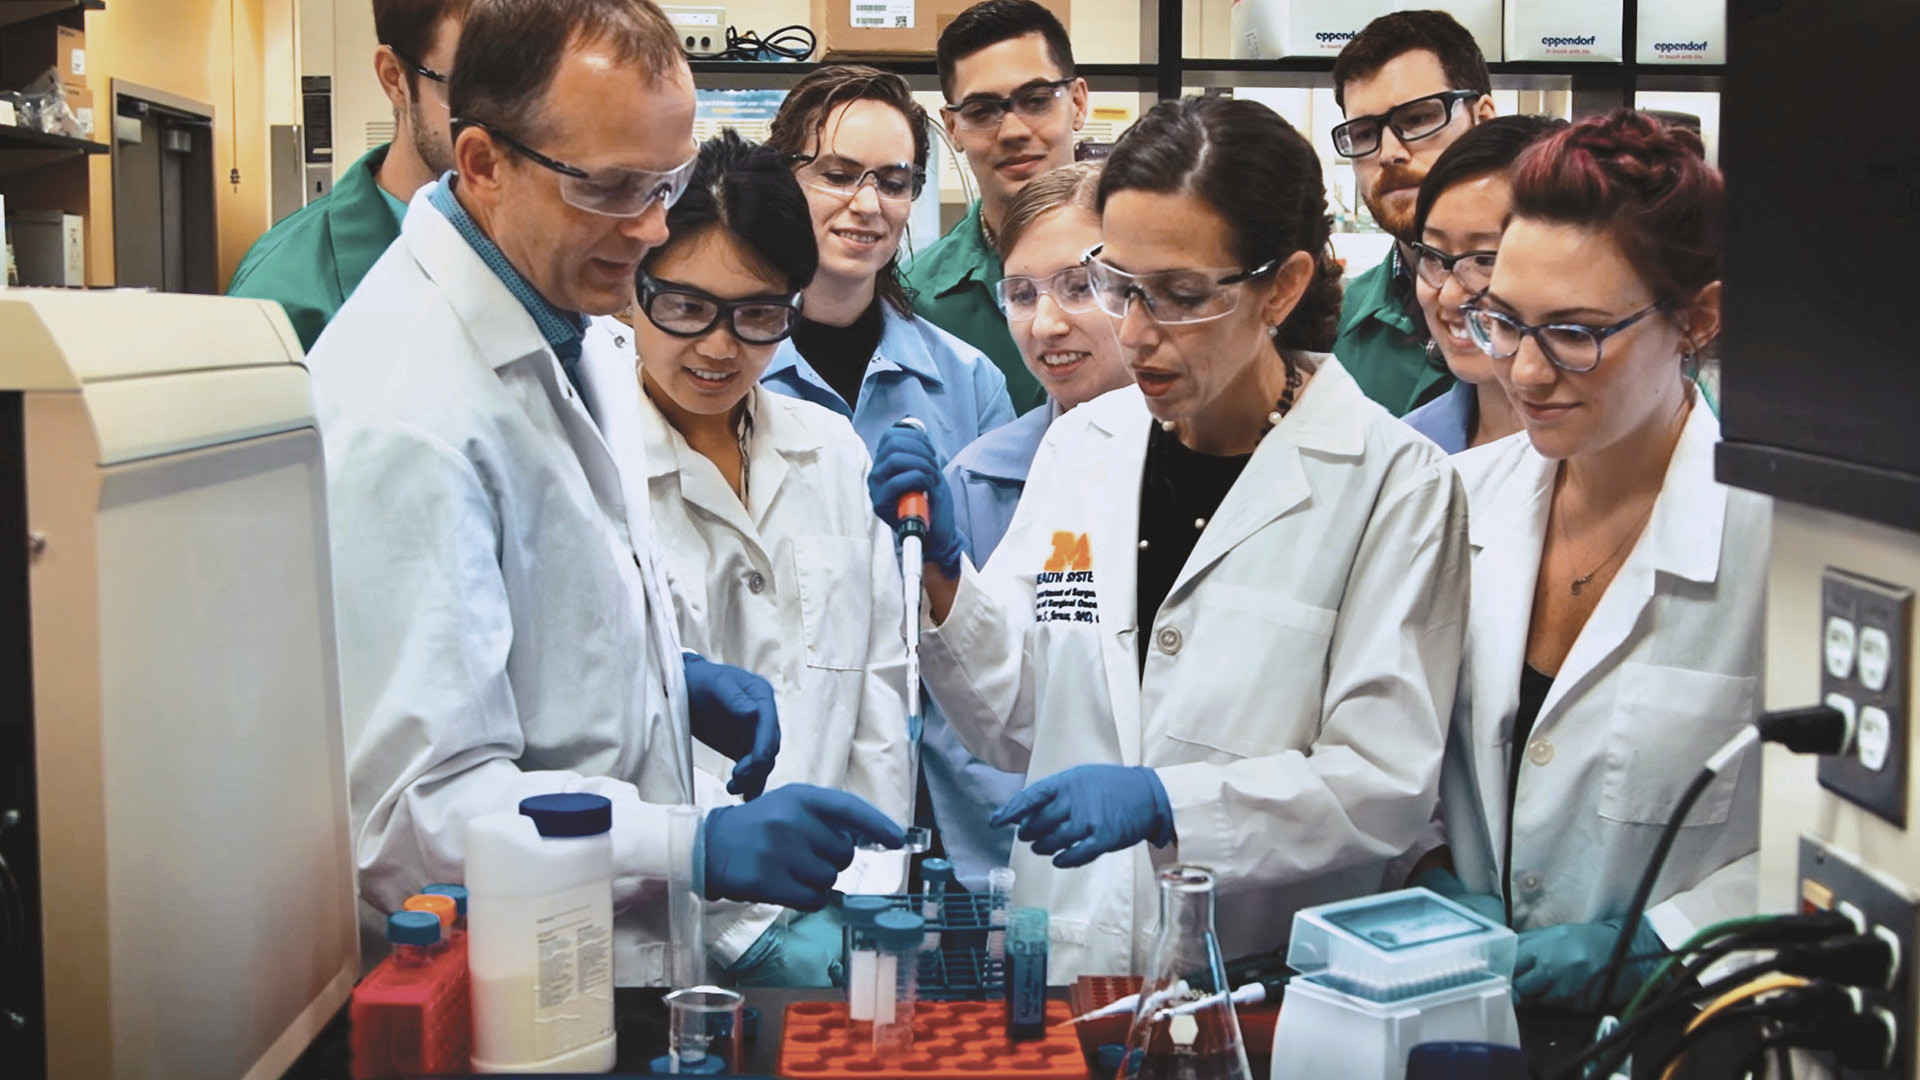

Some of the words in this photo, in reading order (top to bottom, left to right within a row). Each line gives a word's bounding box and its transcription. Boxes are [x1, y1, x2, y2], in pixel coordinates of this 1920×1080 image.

[1315, 30, 1355, 42] eppend
[1541, 35, 1596, 47] eppendorf
[1654, 41, 1708, 53] eppendorf
[1044, 531, 1091, 571] M
[1037, 572, 1064, 585] EALTH
[1066, 571, 1094, 583] SYSTE
